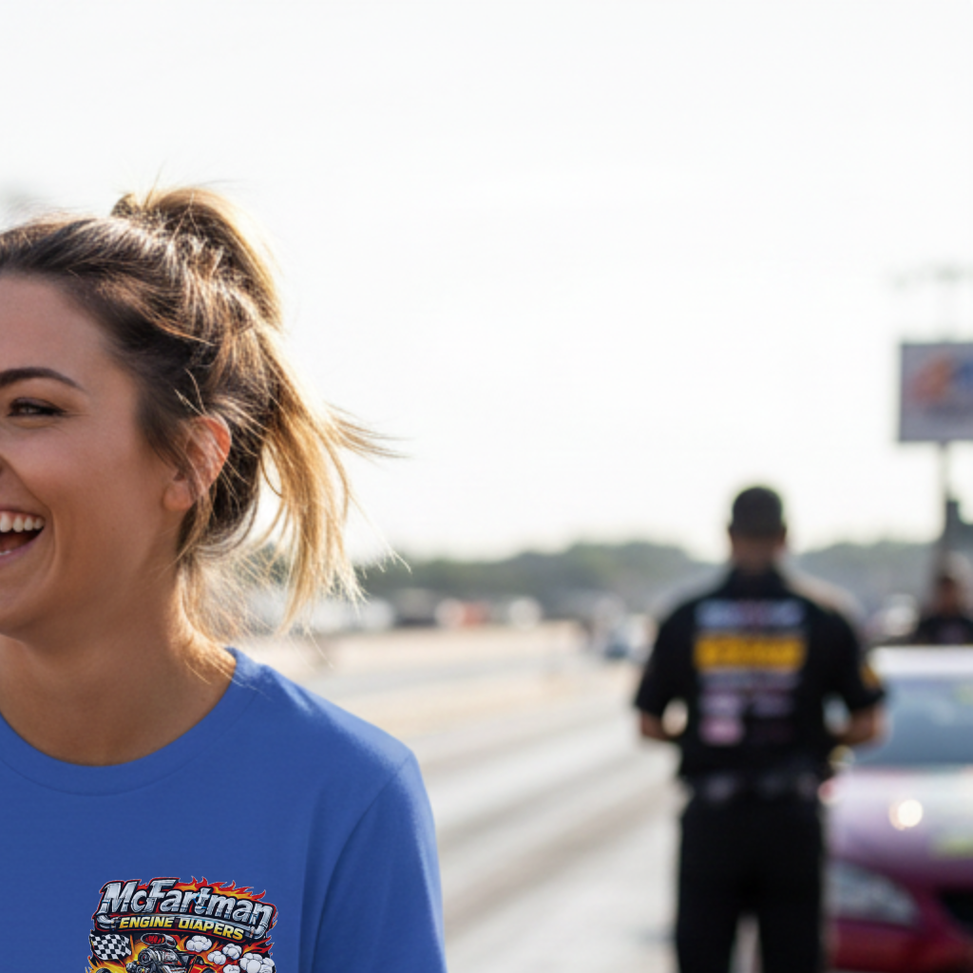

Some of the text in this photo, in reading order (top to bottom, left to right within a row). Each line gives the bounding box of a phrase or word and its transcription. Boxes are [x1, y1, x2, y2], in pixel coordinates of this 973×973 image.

[96, 879, 273, 931] McFartman
[119, 916, 245, 941] ENGINE DIAPERS
